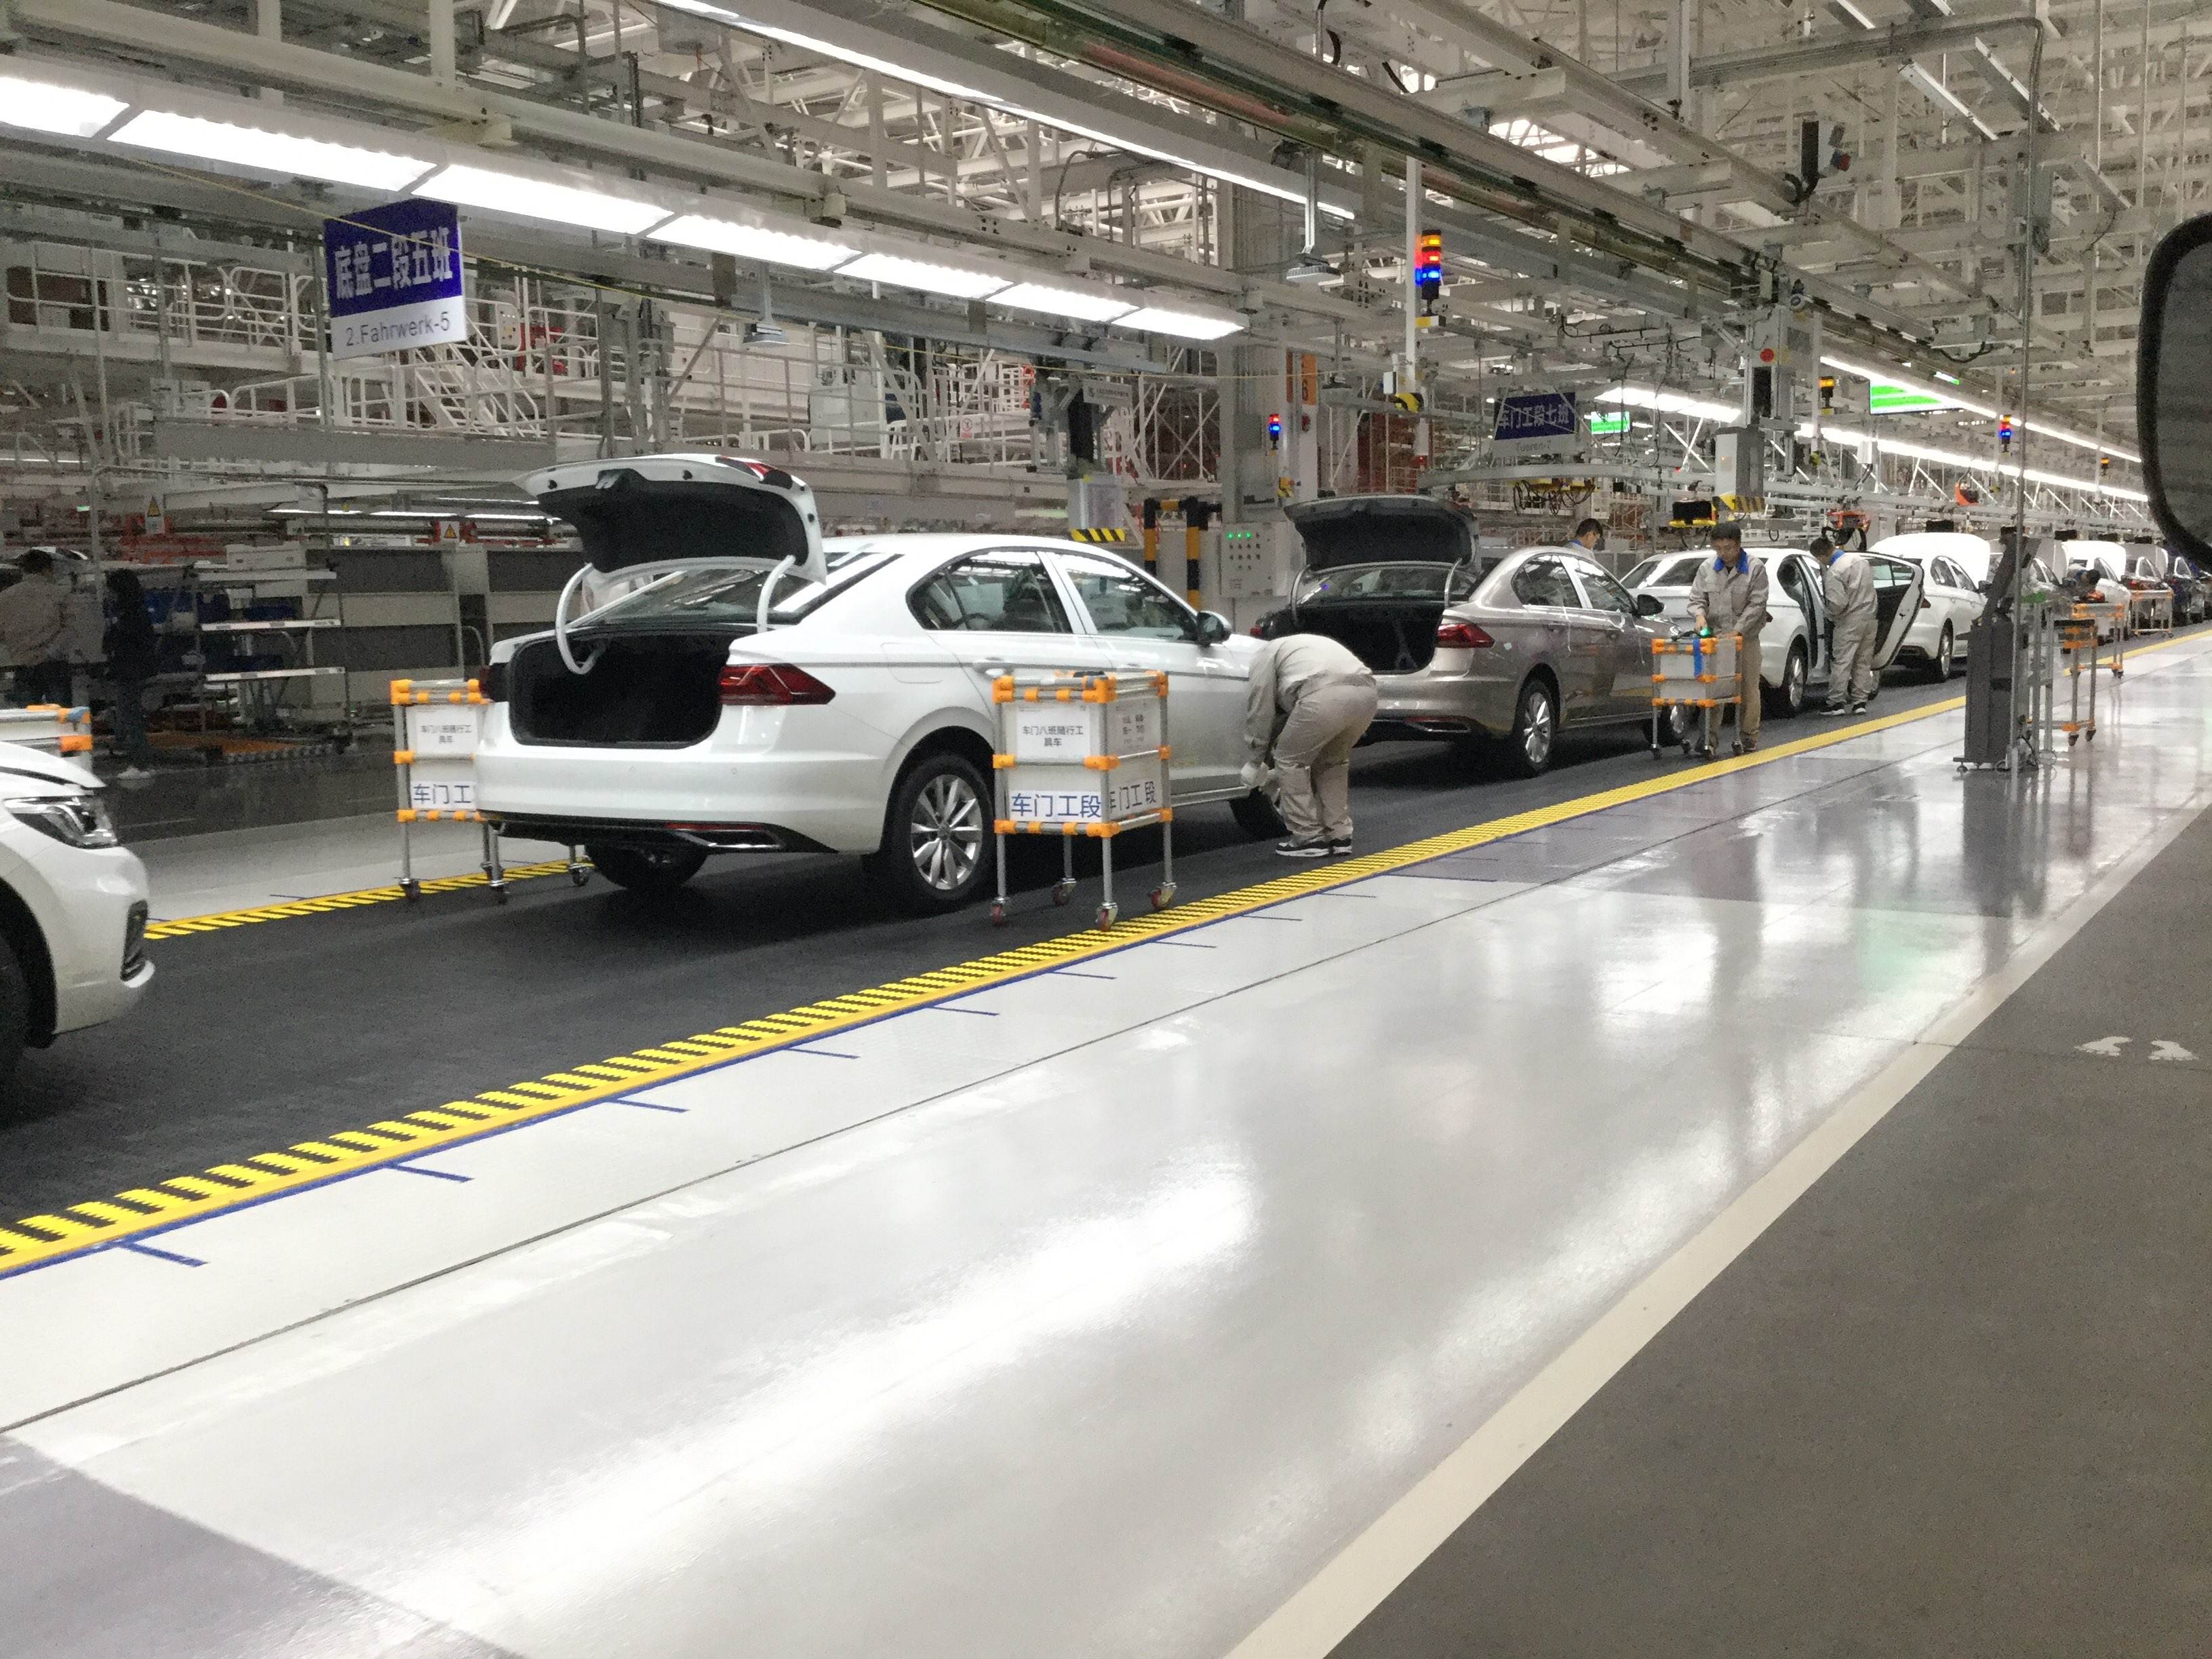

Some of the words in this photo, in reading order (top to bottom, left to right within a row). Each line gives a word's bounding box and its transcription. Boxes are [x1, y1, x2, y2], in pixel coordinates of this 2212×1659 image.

[334, 226, 453, 299] 底盘二段五班
[346, 311, 451, 346] 2.Fahrwerk-5
[413, 783, 472, 804] 车门工
[1011, 793, 1102, 818] 车门工段
